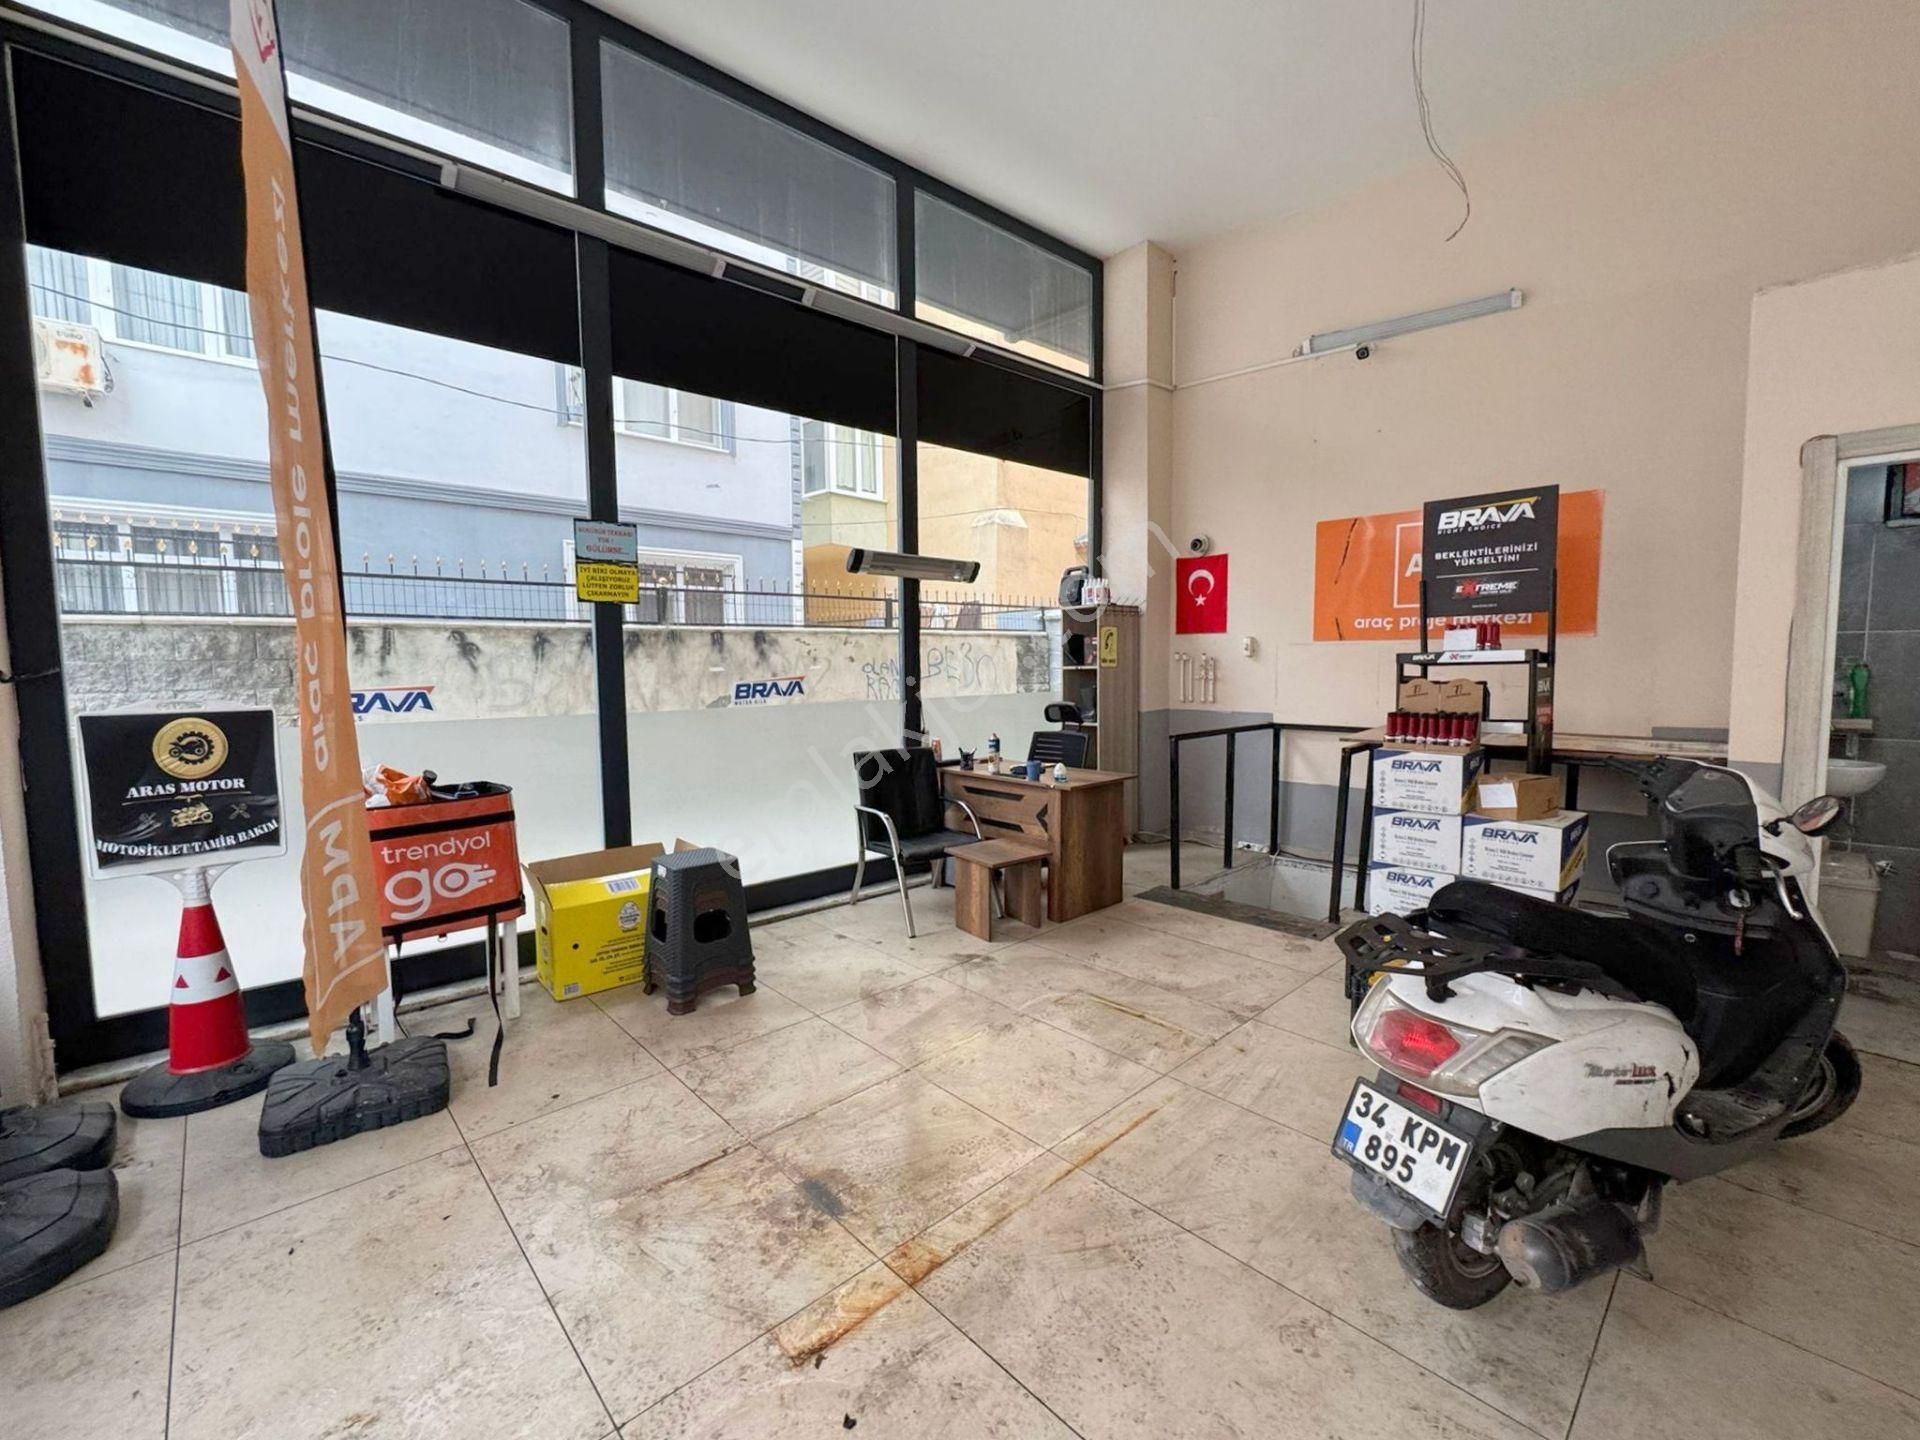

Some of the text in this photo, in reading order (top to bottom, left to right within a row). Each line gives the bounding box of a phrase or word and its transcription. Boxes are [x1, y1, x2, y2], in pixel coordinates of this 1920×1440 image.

[1437, 502, 1536, 530] BRAVA
[1467, 523, 1502, 532] CHOICE
[1434, 542, 1539, 560] BEKLENTİLERİNİZİ
[1454, 553, 1521, 567] YÜKSELTİN!
[1354, 615, 1394, 631] araç
[734, 681, 805, 700] BRAVA
[351, 691, 434, 714] RAVA
[1391, 759, 1442, 773] BRAVA
[126, 777, 246, 799] ARAS MOTOR
[1391, 816, 1441, 831] BRAVA
[96, 818, 279, 857] MOTOSİKLET TAMİR BAKIM
[1481, 827, 1539, 845] BRAVA
[380, 831, 492, 865] trendyol
[1386, 871, 1435, 889] BRAVA
[384, 862, 497, 921] go
[1356, 1092, 1461, 1172] 34 KPM
[1342, 1137, 1354, 1152] TR
[1364, 1134, 1417, 1183] 895
